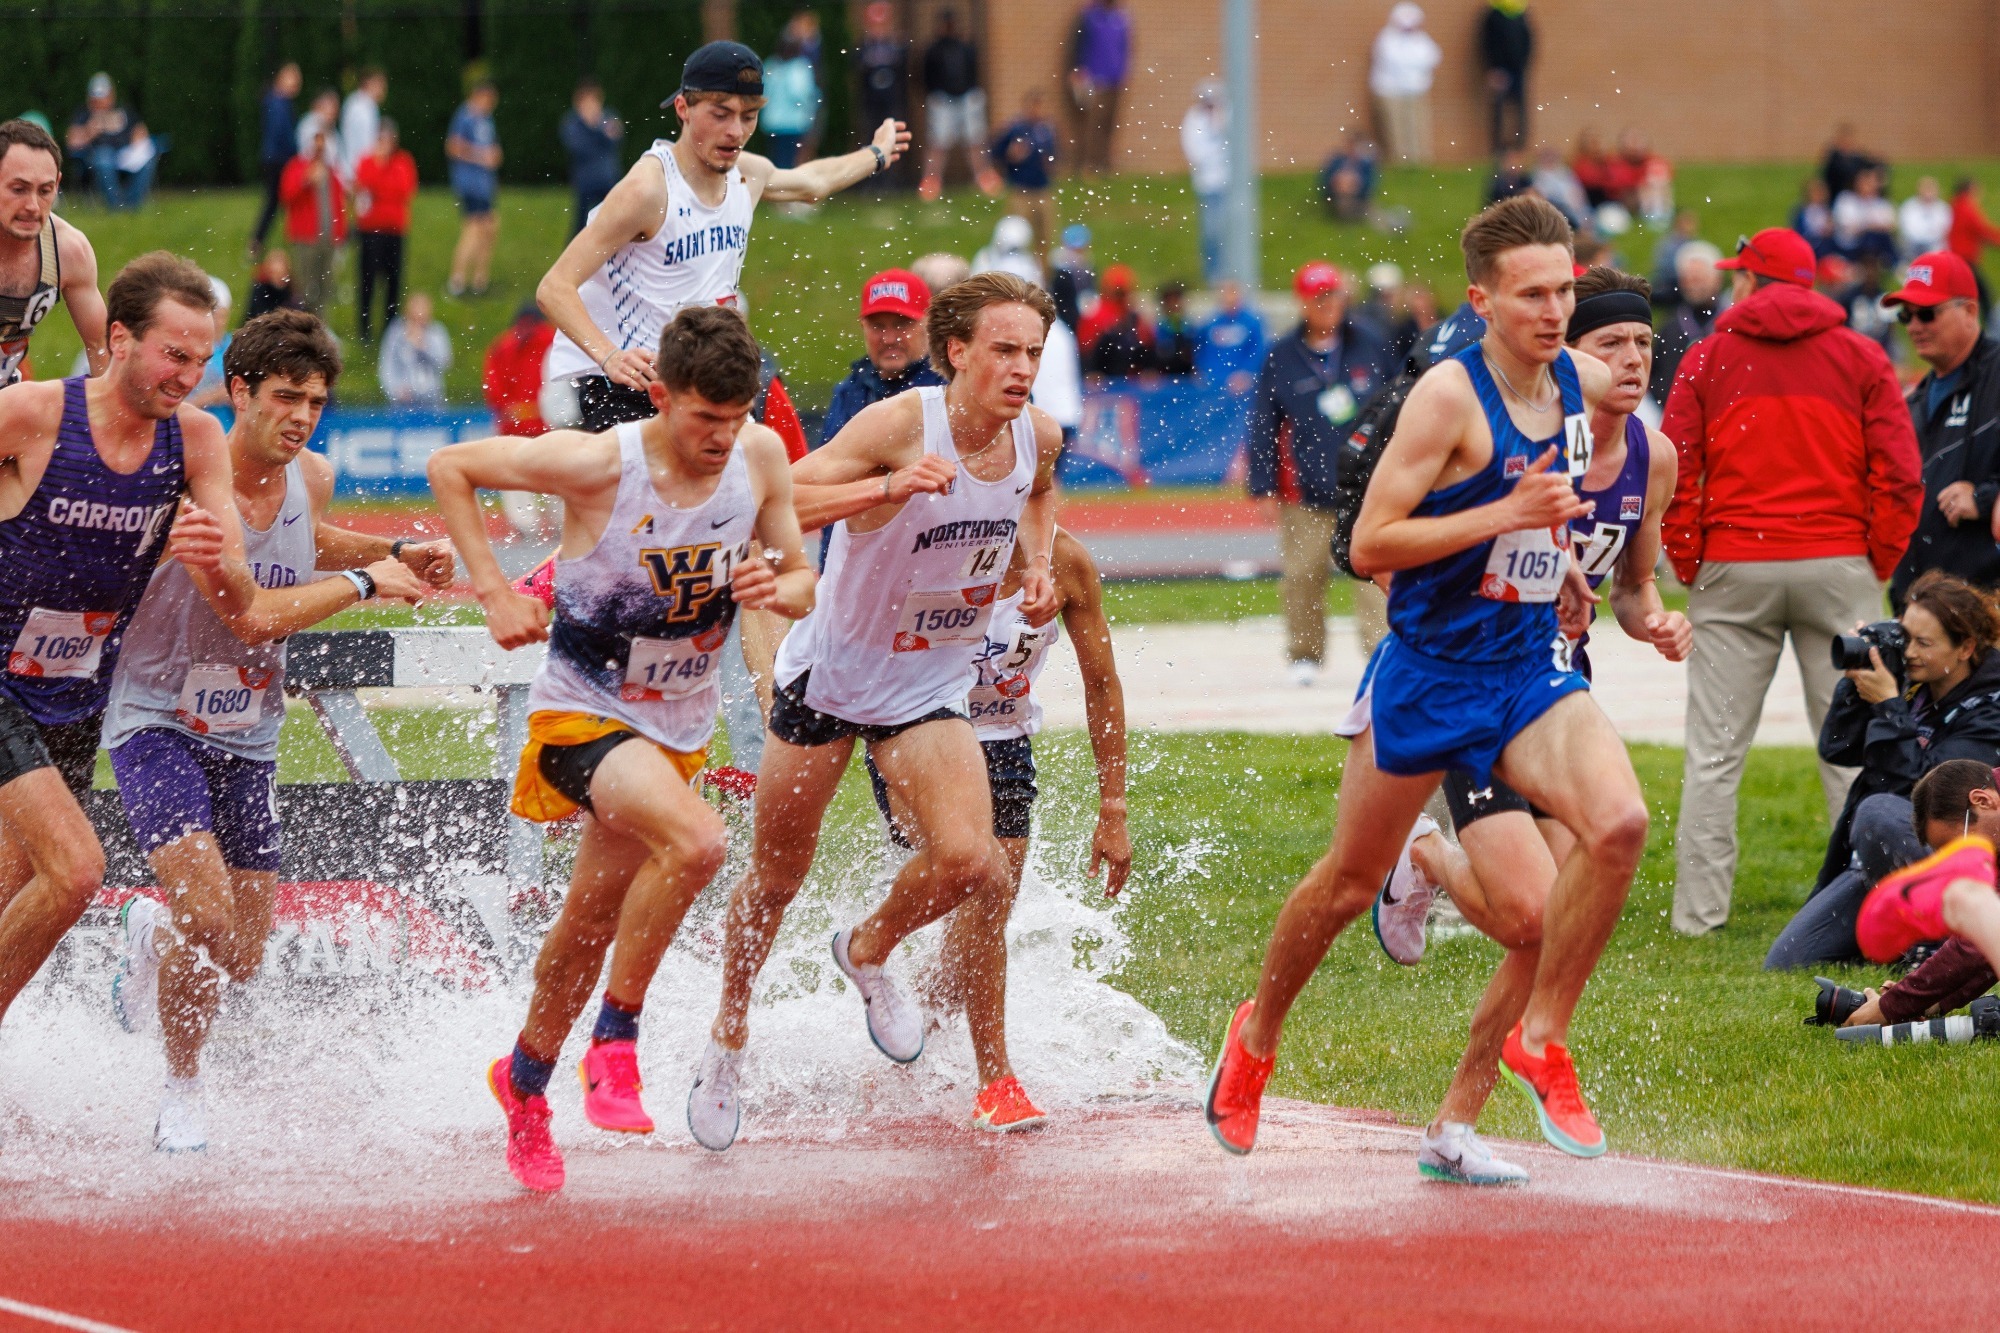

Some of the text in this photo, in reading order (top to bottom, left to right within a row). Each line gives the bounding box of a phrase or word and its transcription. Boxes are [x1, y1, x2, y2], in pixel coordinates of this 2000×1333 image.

[663, 229, 705, 266] SAINT
[1572, 419, 1590, 470] 4
[911, 519, 1017, 554] NORTHWEST
[935, 539, 1005, 550] UNIVERSITY
[1587, 528, 1620, 572] 7
[969, 546, 1001, 576] 14
[1506, 551, 1560, 580] 1051
[914, 607, 978, 632] 1509
[33, 635, 94, 660] 1069
[1006, 632, 1033, 668] 5
[644, 653, 710, 685] 1749
[195, 688, 251, 714] 1680
